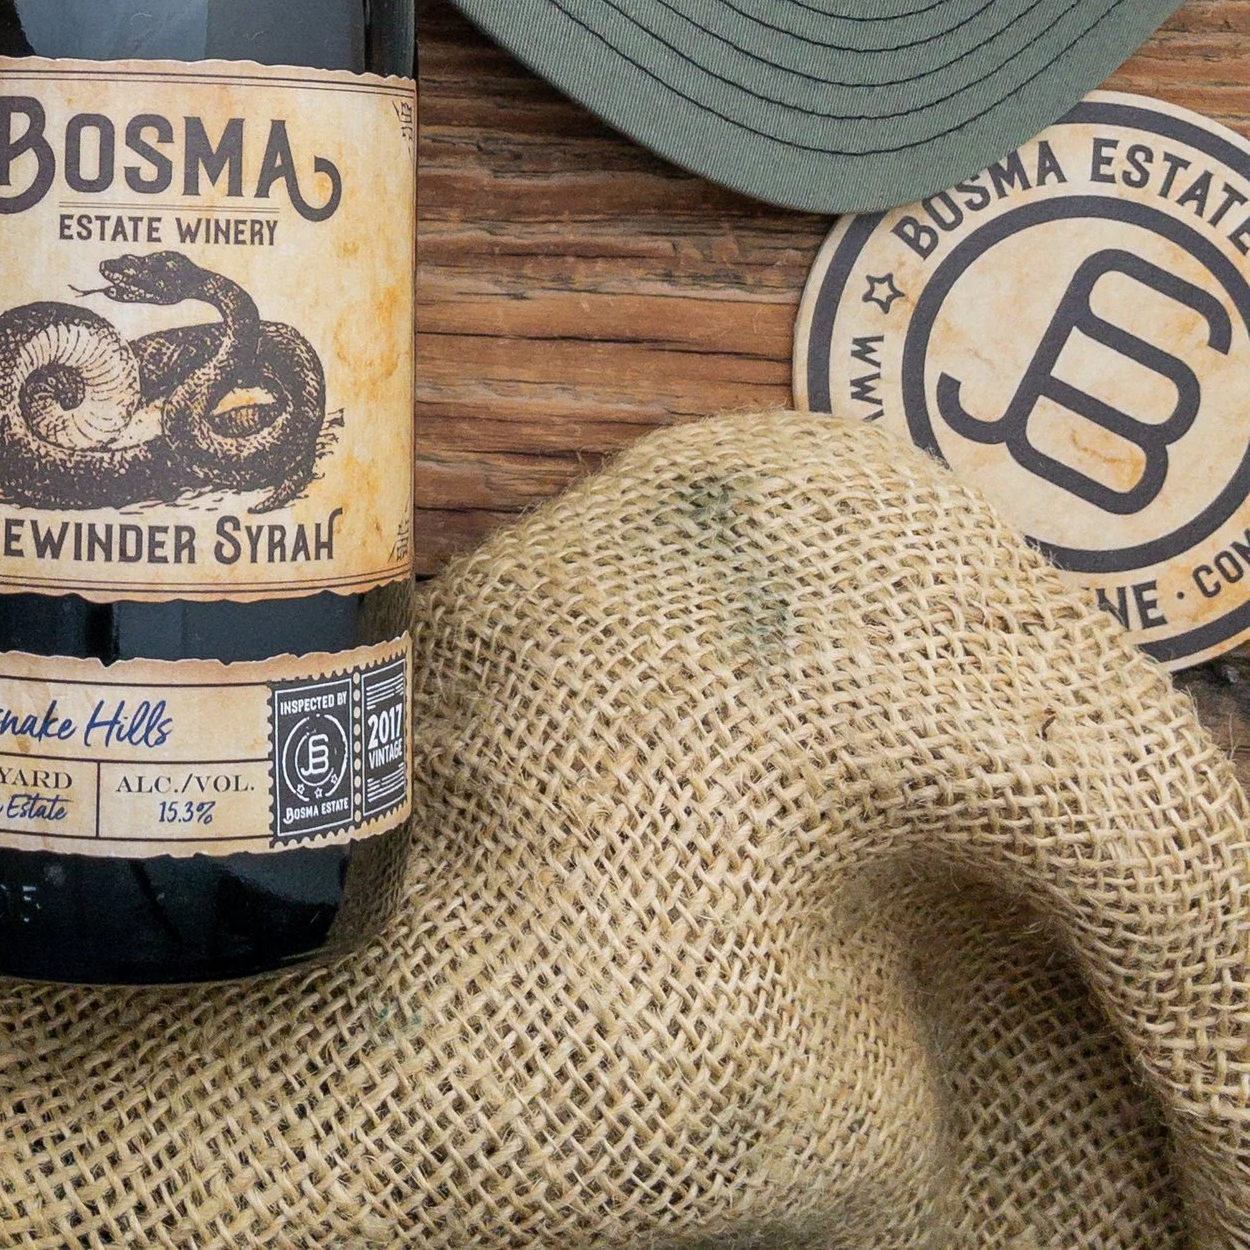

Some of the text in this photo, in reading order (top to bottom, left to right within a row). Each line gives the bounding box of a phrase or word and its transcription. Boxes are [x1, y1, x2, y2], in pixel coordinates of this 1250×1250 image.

[890, 140, 1068, 261] BOSMA
[58, 213, 279, 247] ESTATE WINERY
[213, 507, 343, 564] SYRAH
[280, 690, 348, 716] INSPECTED BY
[82, 699, 174, 749] Hills
[367, 702, 404, 750] 2017
[368, 738, 404, 770] VINTAGE
[116, 772, 256, 795] ALC./VOL.
[6, 793, 74, 821] Estate
[158, 801, 216, 825] 15.3%
[283, 797, 349, 825] BOSMA ESTATE
